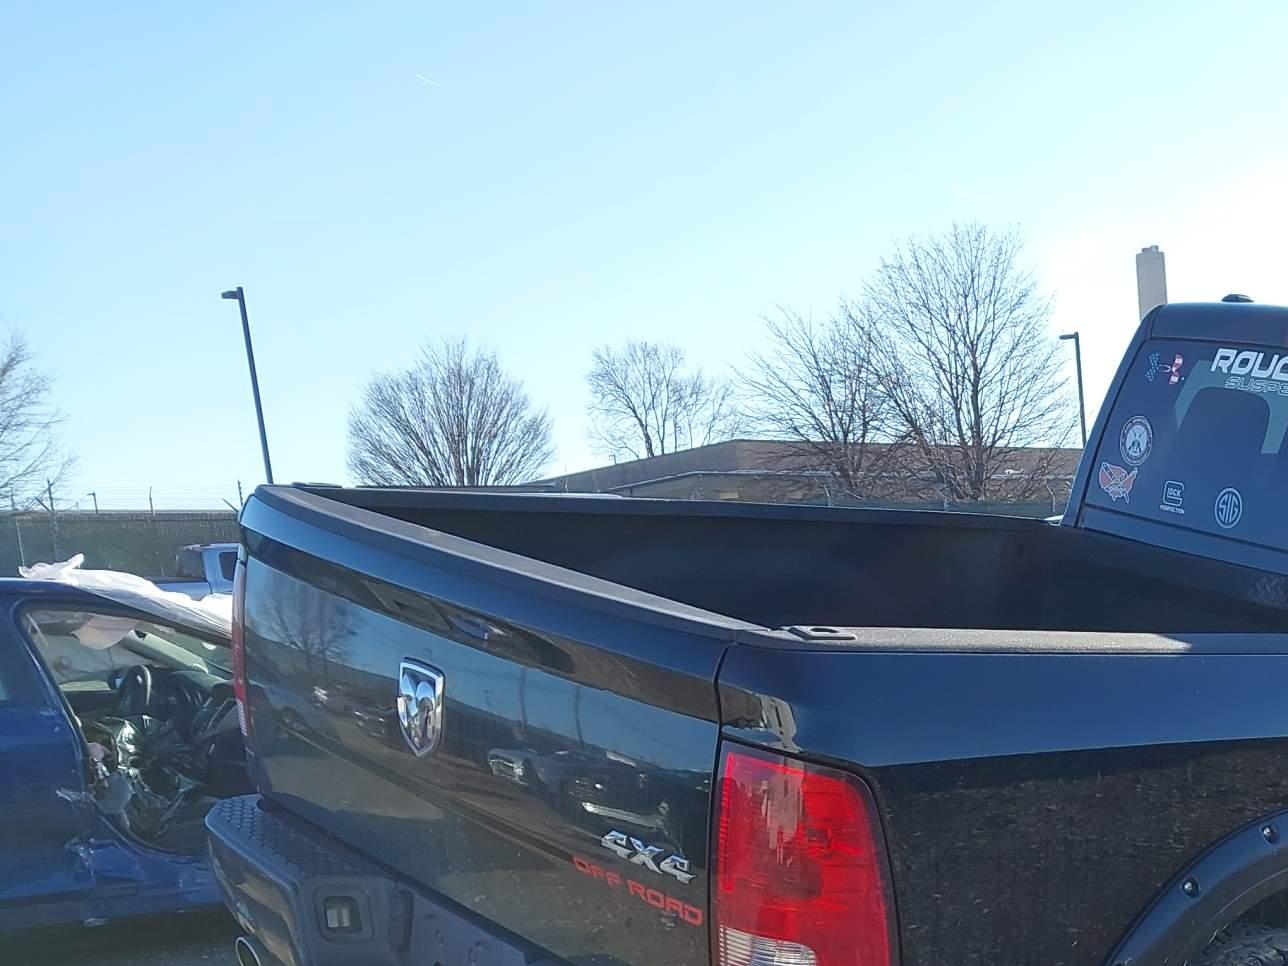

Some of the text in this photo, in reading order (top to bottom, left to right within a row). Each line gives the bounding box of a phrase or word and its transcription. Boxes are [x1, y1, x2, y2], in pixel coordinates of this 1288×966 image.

[1217, 492, 1240, 525] SIG
[572, 855, 704, 926] OFF ROAD
